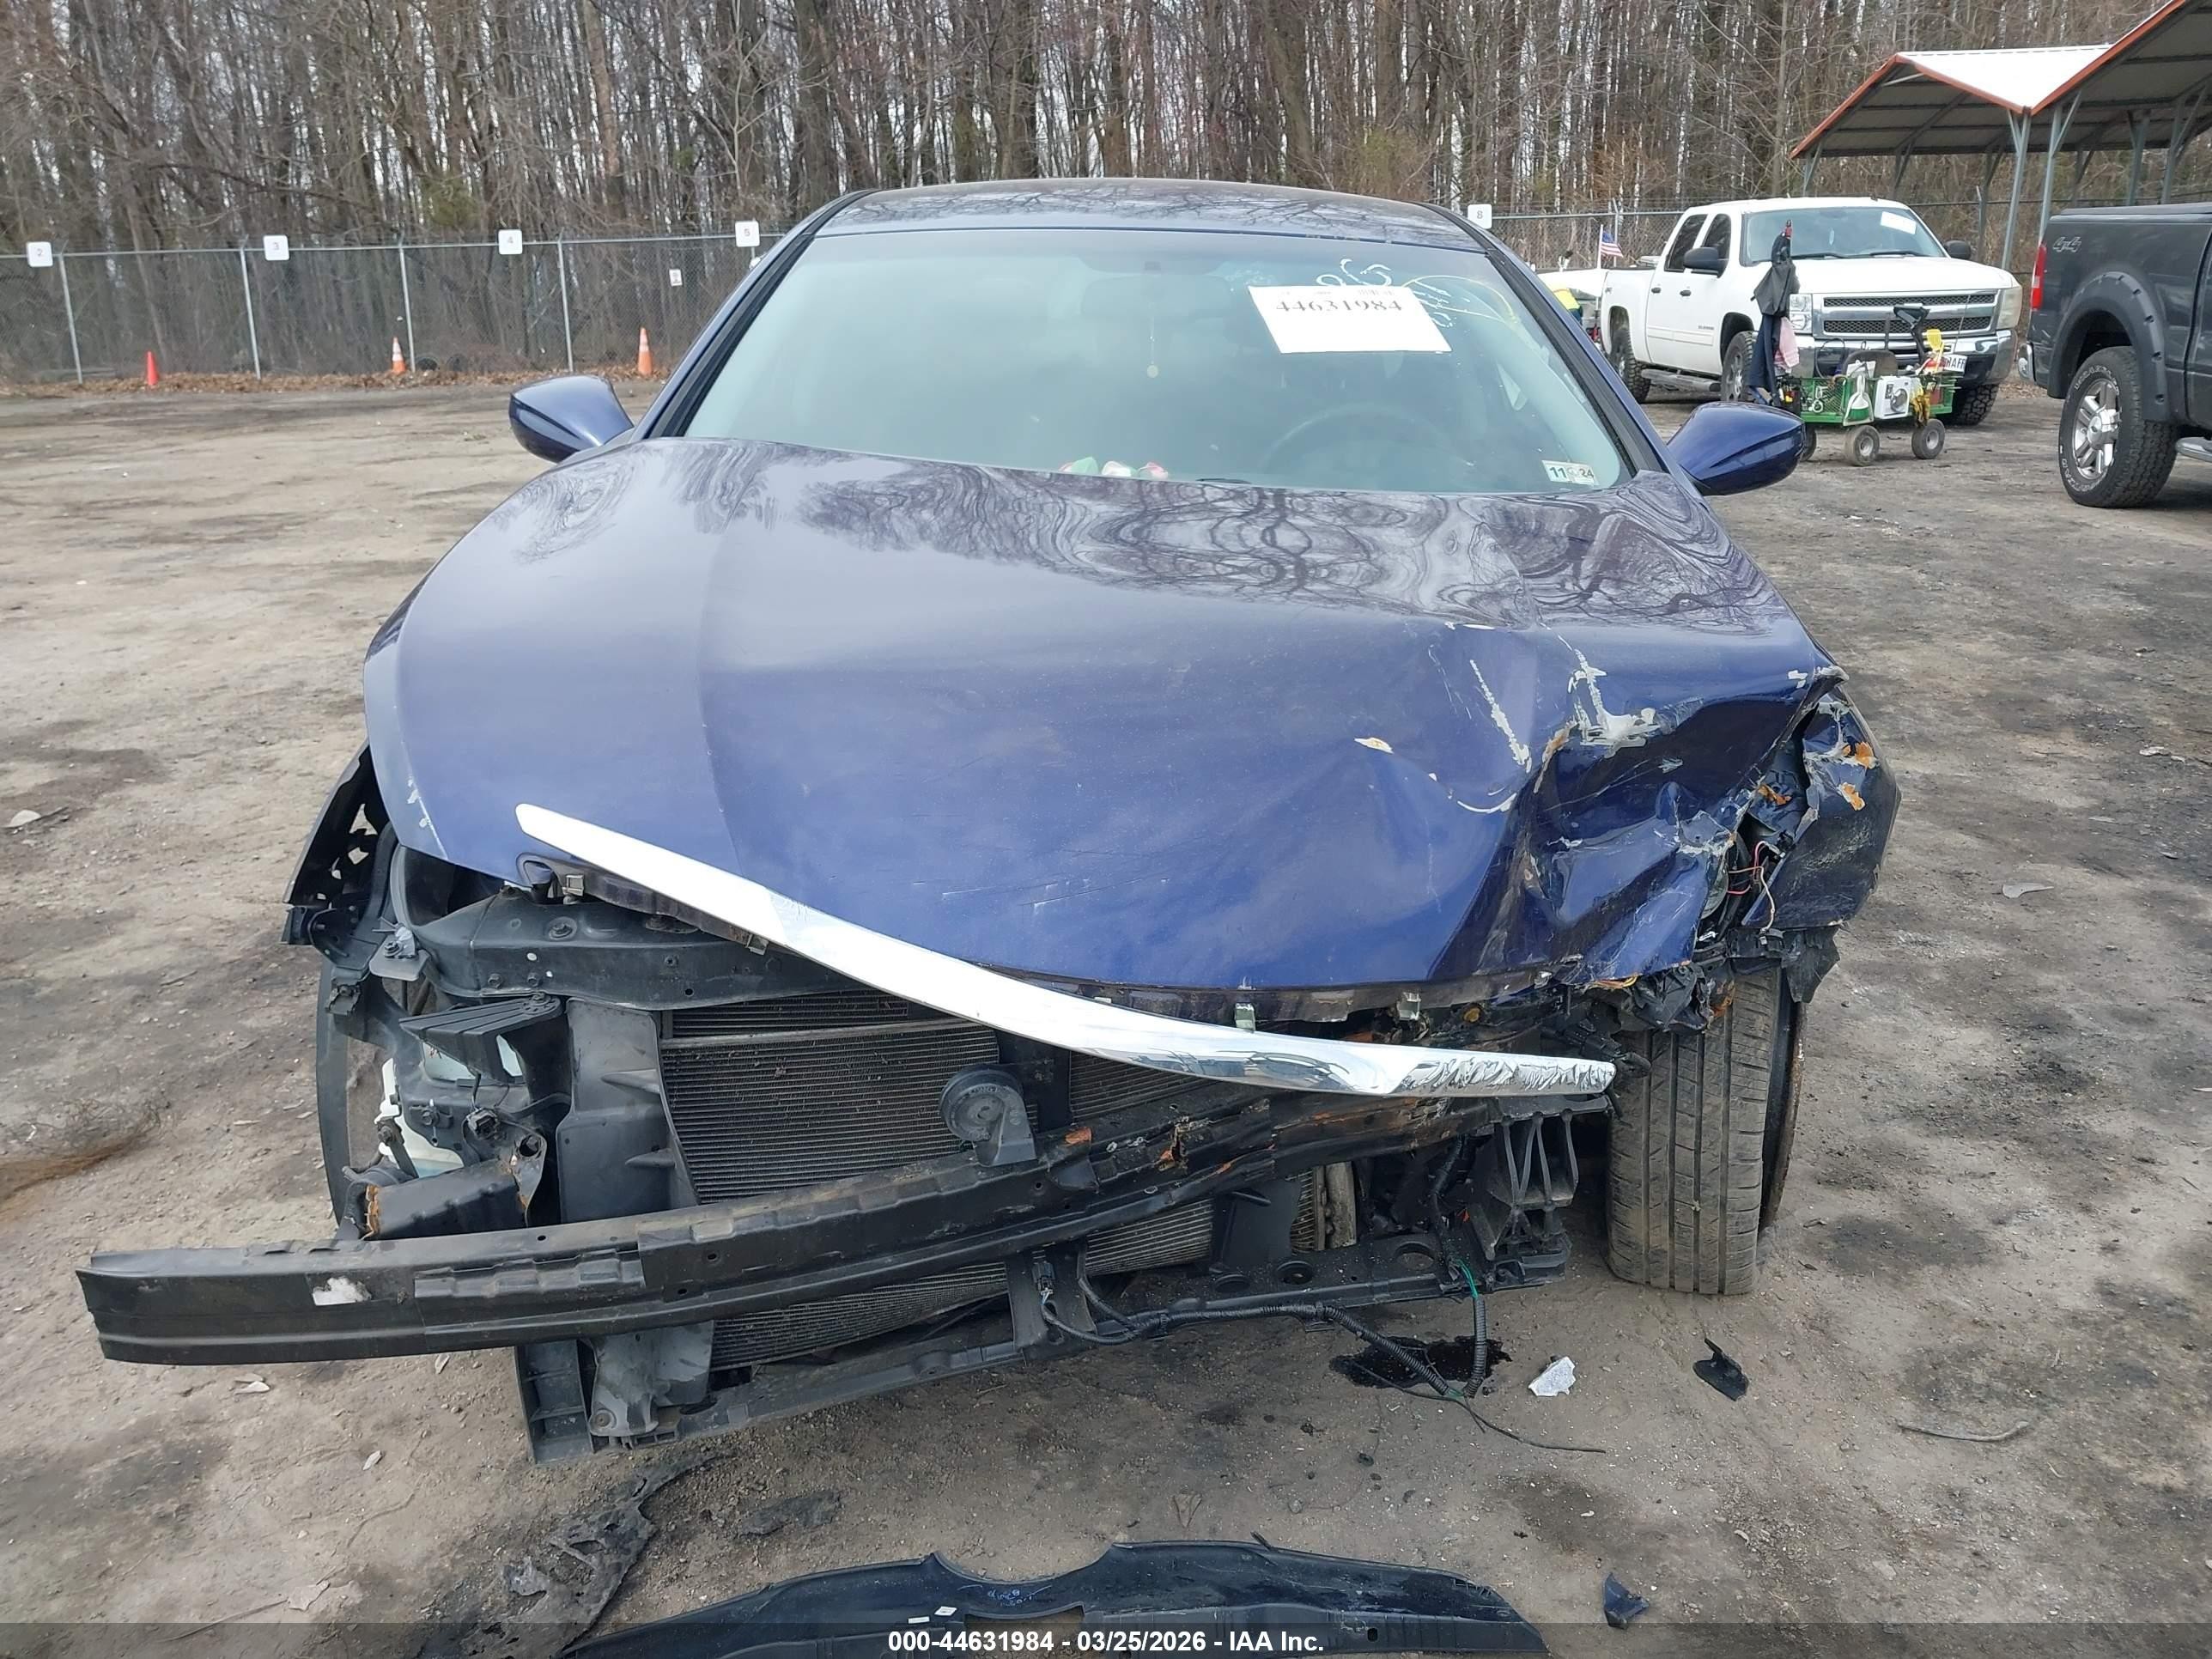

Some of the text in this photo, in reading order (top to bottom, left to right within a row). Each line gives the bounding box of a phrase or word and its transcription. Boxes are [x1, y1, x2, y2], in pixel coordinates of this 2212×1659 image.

[1275, 300, 1402, 312] 44631984
[1549, 466, 1595, 479] 11 24
